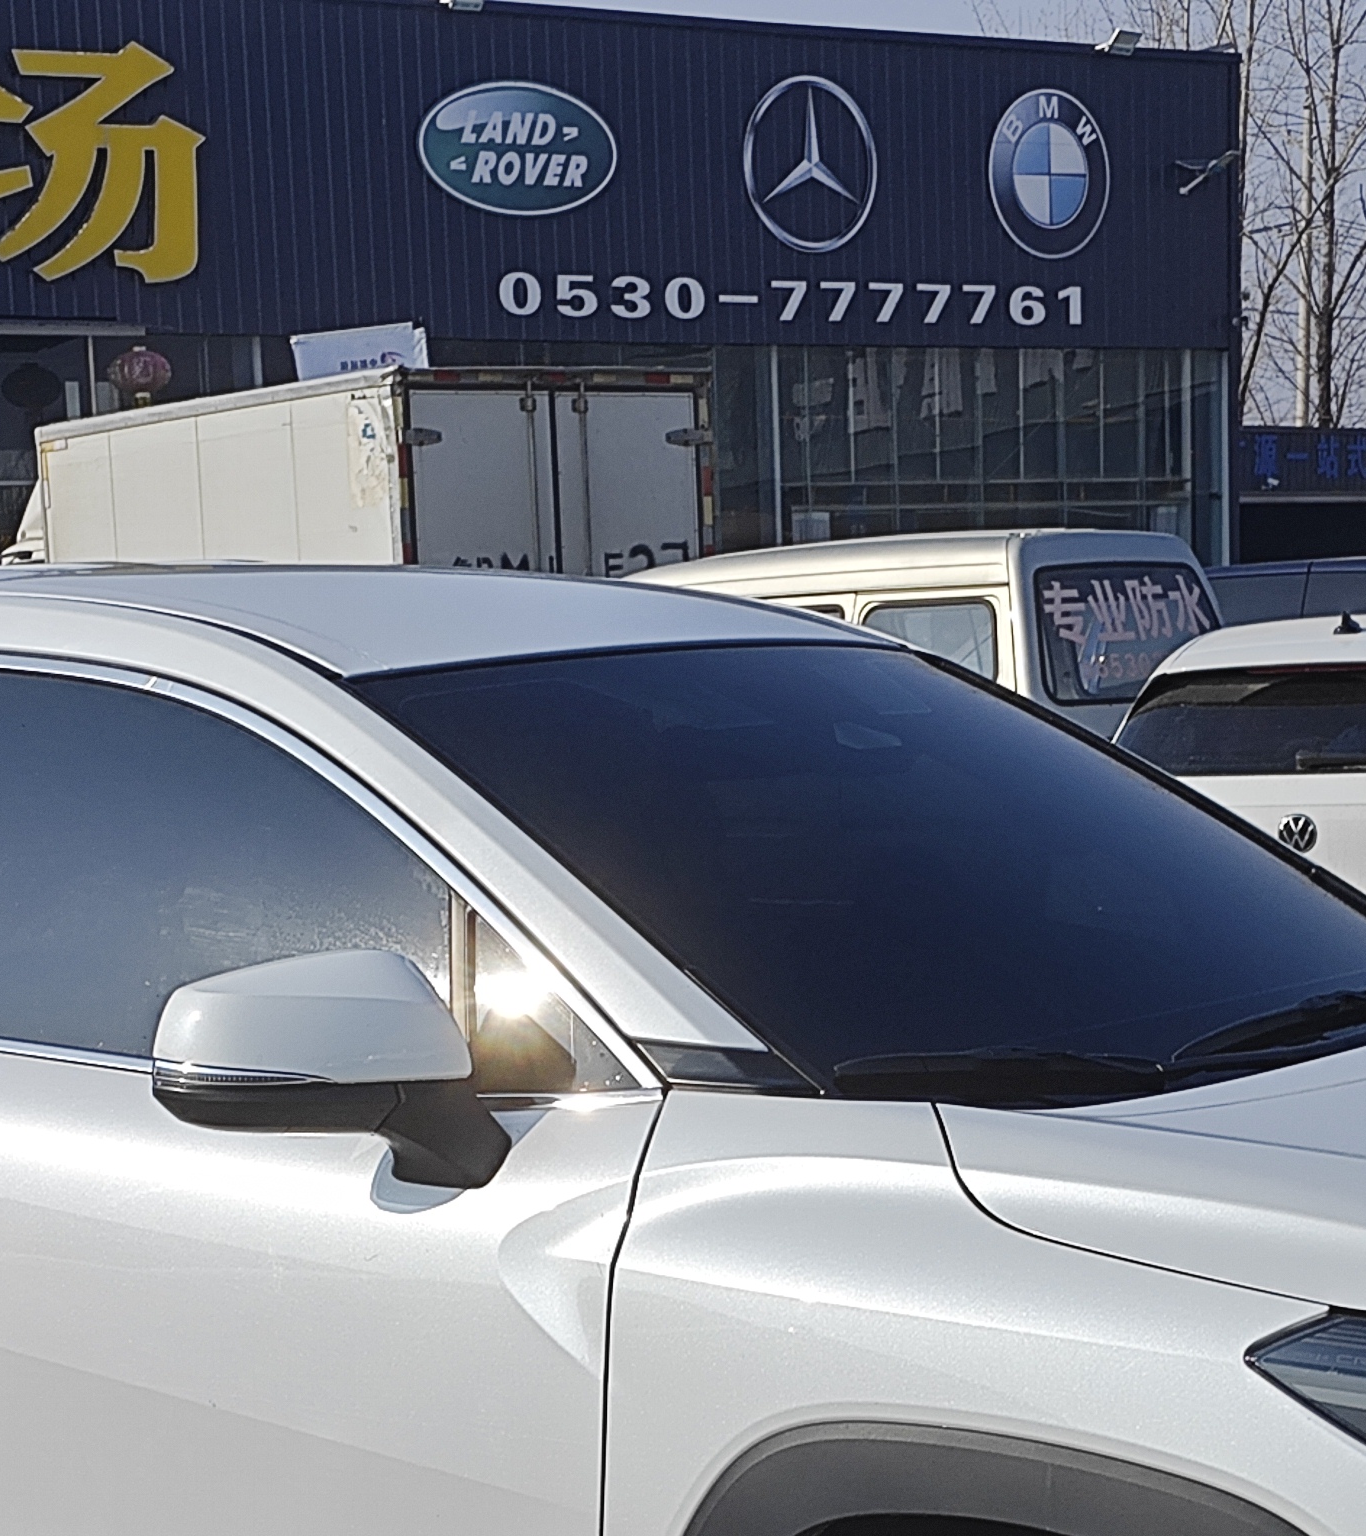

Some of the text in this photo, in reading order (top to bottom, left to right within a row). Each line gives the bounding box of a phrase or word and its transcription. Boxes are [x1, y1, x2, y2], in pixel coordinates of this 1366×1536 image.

[459, 110, 552, 147] LAND
[1002, 95, 1097, 147] BMW
[472, 152, 589, 188] ROVER
[498, 271, 1084, 326] 0530-7777761
[1042, 574, 1211, 646] 专业防水
